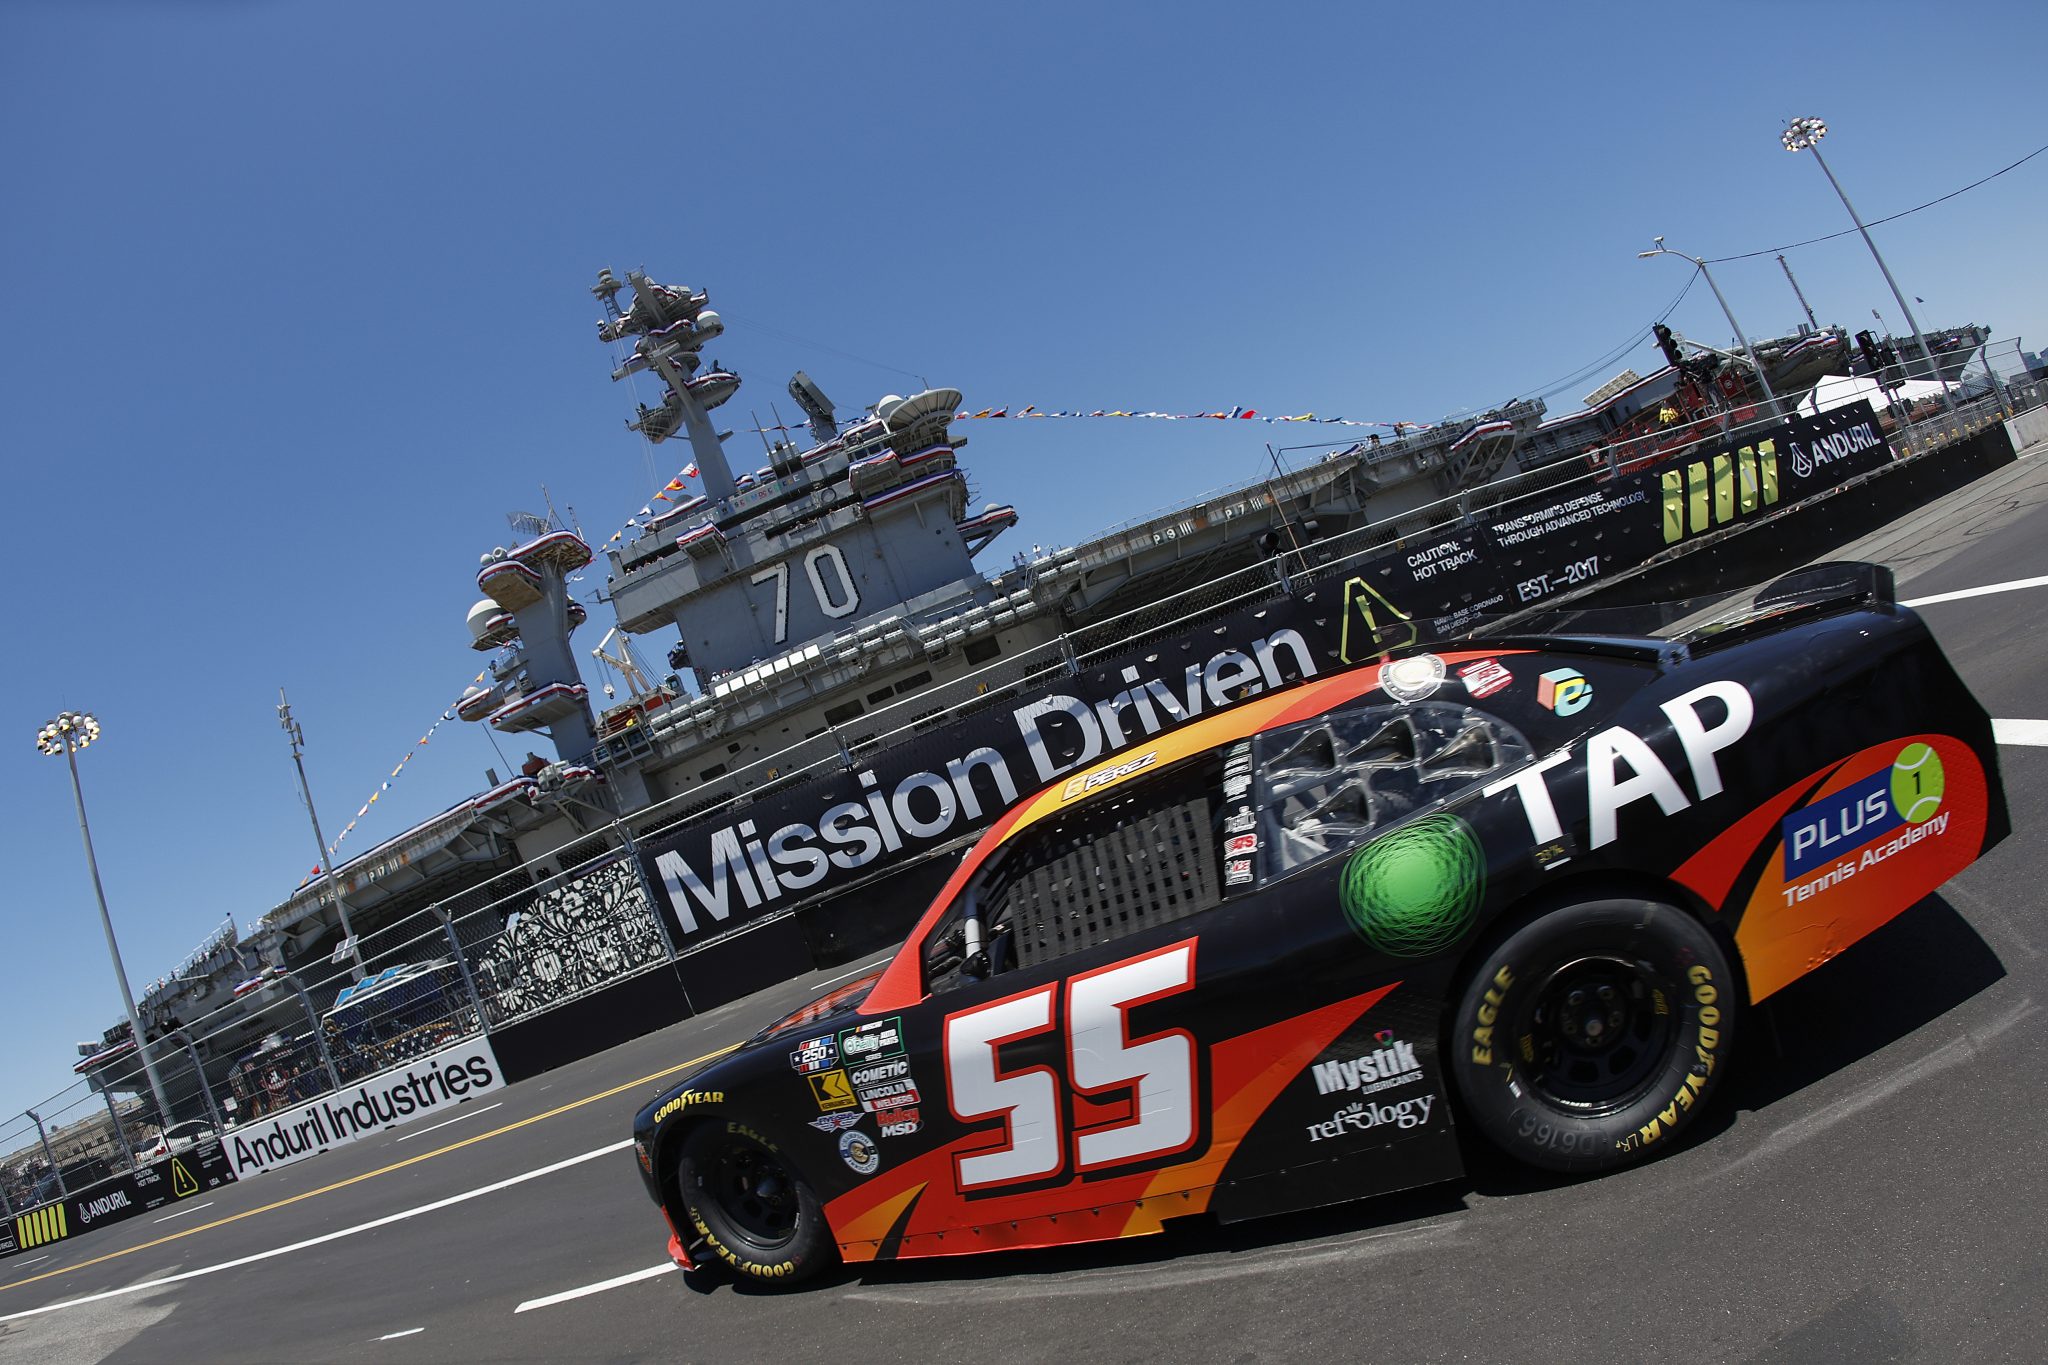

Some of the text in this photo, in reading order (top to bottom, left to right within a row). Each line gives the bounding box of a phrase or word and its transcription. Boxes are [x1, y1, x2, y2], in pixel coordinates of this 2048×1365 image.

[1811, 422, 1881, 467] ANDURIL
[1491, 491, 1604, 536] TRANSFORMING DEFENSE
[1497, 490, 1646, 548] THROUGH ADVANCED TECHNOLOGY
[1407, 541, 1461, 567] CAUTION:
[1412, 549, 1478, 582] HOT TRACK
[751, 544, 862, 645] 70
[1453, 607, 1469, 618] BASE
[1469, 594, 1504, 613] CORONADO
[655, 628, 1318, 933] Mission Driven
[1483, 680, 1754, 871] TAP
[1793, 770, 1920, 861] PLUS 1
[1782, 810, 1950, 907] Tennis Academy
[1472, 964, 1515, 1066] EAGLE
[801, 1046, 827, 1063] 250
[851, 1061, 908, 1085] COMETIC
[942, 935, 1199, 1202] 55
[1311, 1040, 1424, 1096] Mystik
[1638, 965, 1721, 1146] GOODYEAR
[233, 1107, 329, 1173] Anduril
[323, 1055, 494, 1140] Industries
[653, 1089, 725, 1123] GOODYEAR
[861, 1083, 906, 1101] LINCOLN
[875, 1094, 915, 1108] WELDERS
[876, 1107, 920, 1128] Holley
[881, 1122, 918, 1138] MSD
[89, 1190, 131, 1218] ANDURIL
[209, 1177, 220, 1187] USA
